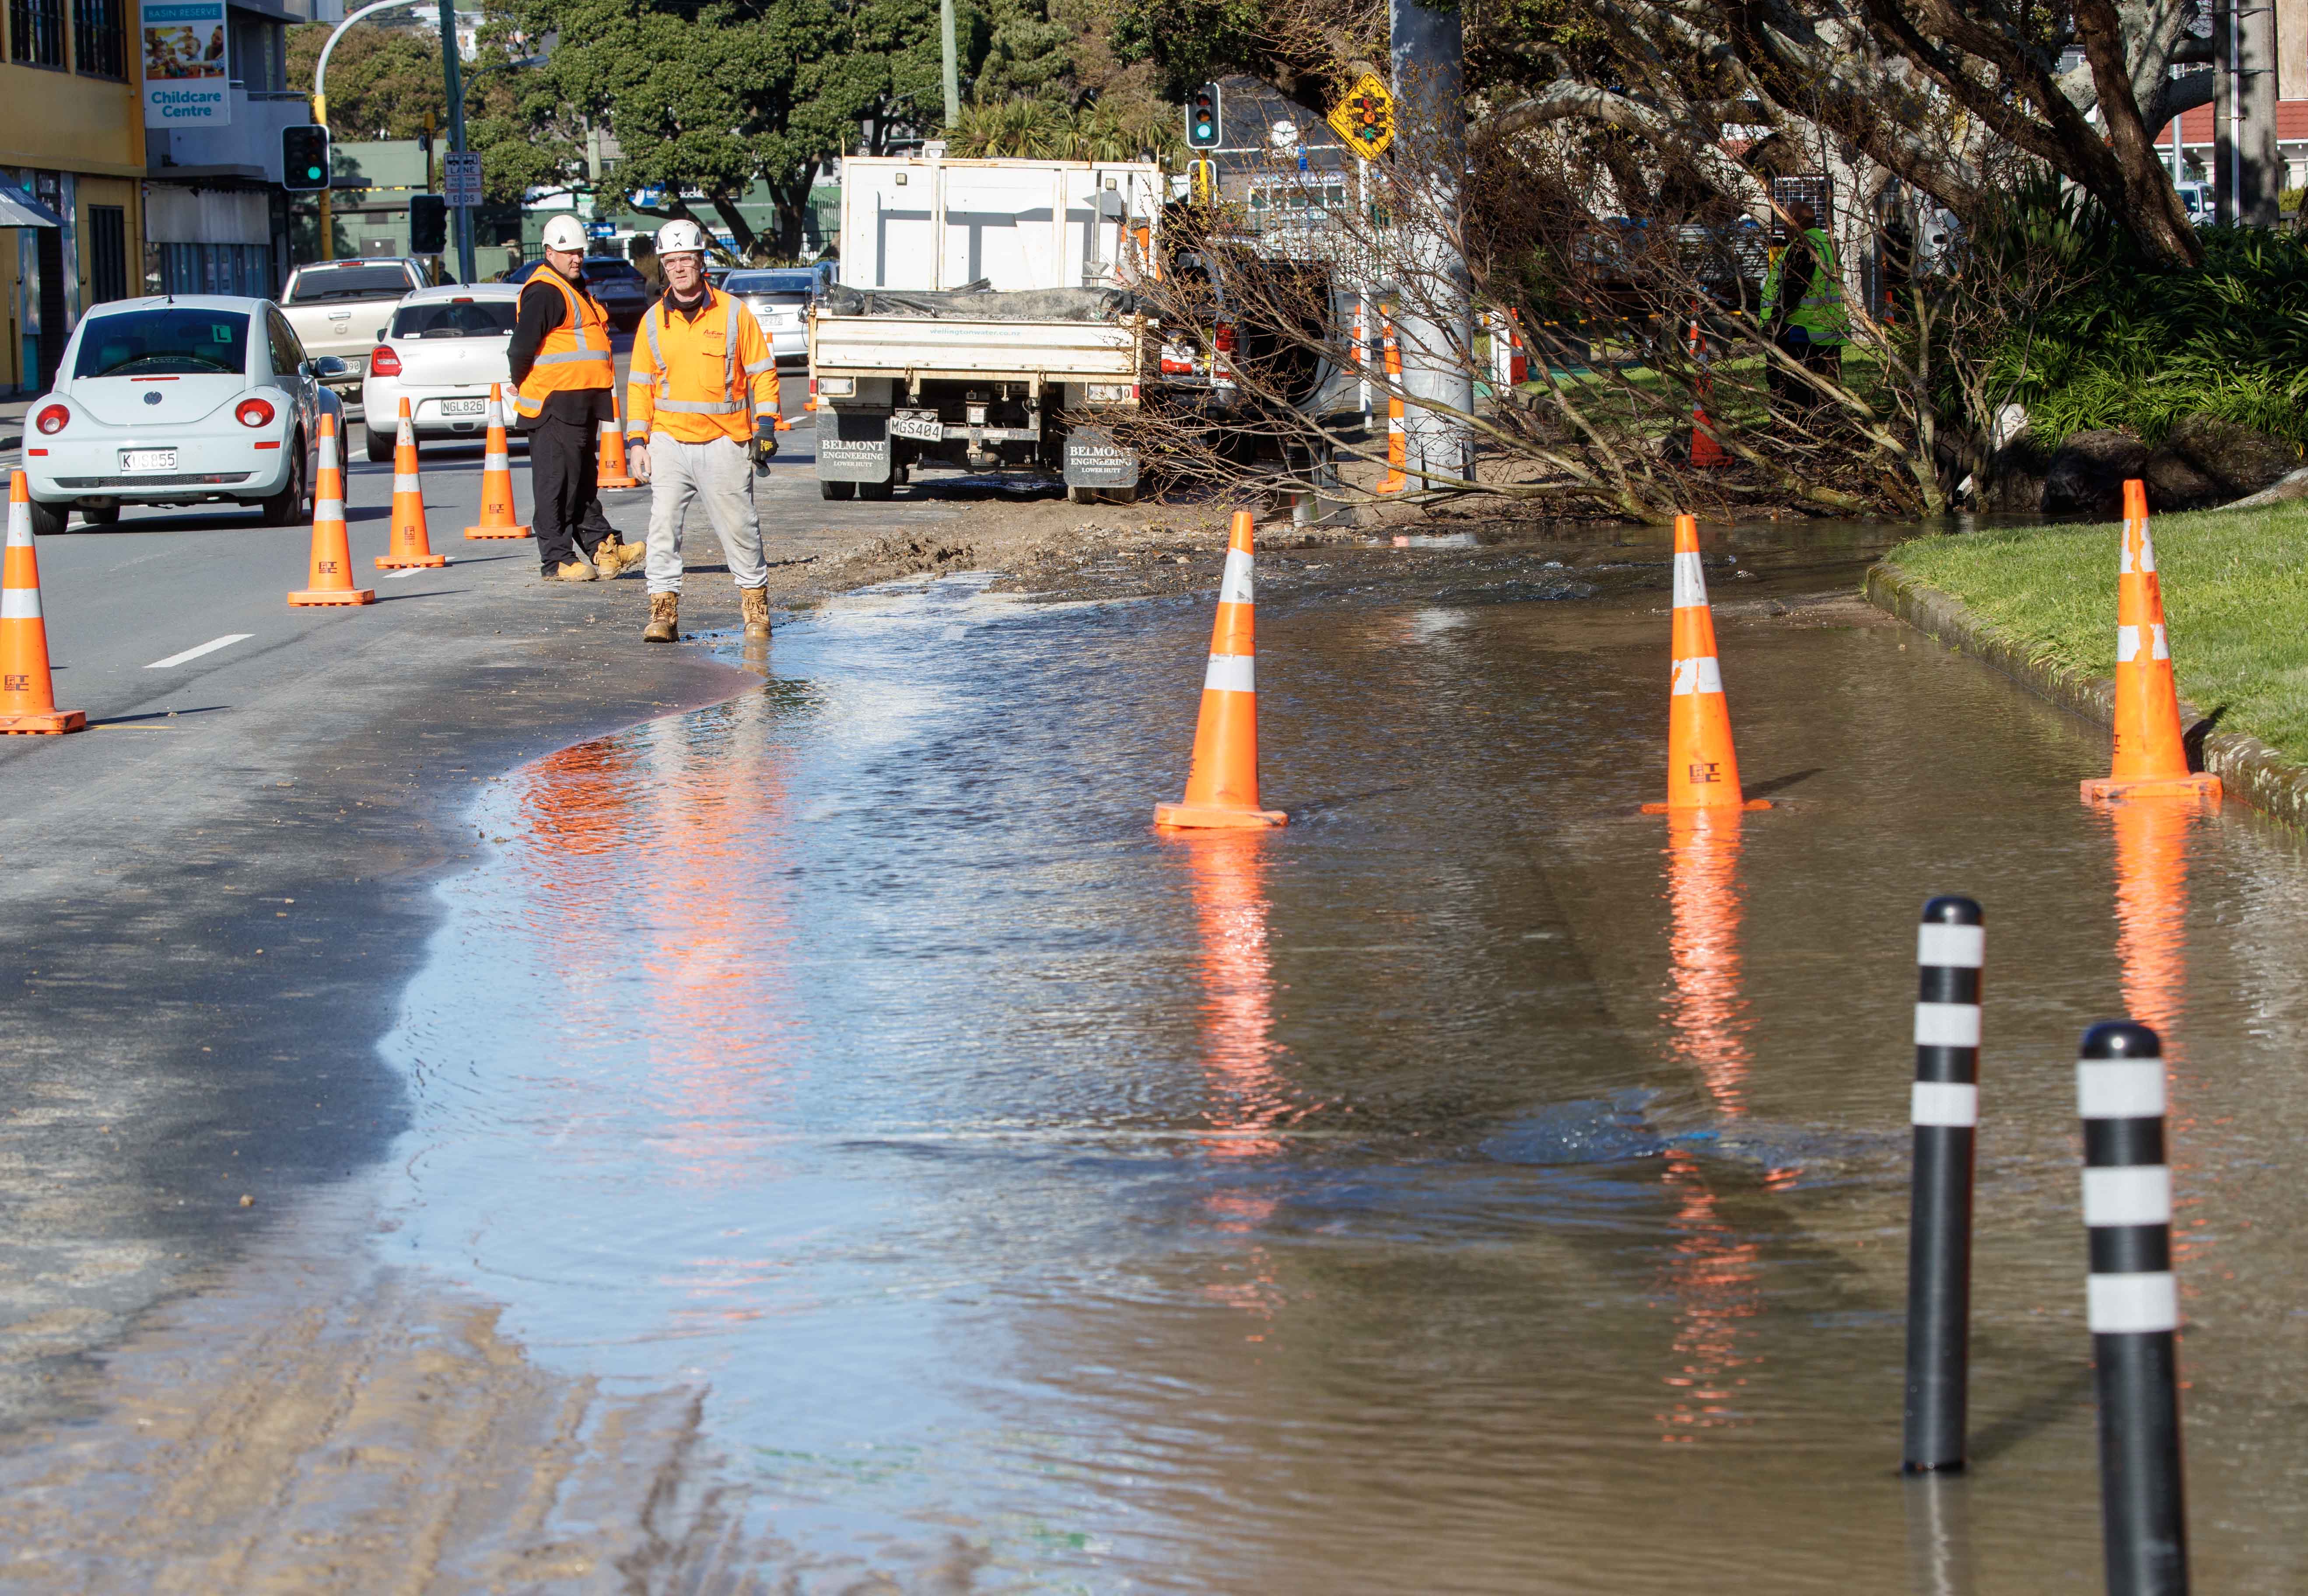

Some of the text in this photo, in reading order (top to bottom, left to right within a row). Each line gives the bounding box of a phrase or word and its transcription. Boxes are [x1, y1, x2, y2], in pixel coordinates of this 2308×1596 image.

[148, 7, 217, 18] BASIN RESERVE
[151, 91, 221, 104] Childcare
[162, 105, 211, 117] Centre
[216, 328, 228, 340] L
[930, 328, 1021, 336] wellingtonwater.co.nz
[443, 401, 482, 412] NGL826
[892, 420, 939, 438] MGS404
[822, 440, 885, 451] BELMONT
[823, 452, 884, 460] ENGINEERING
